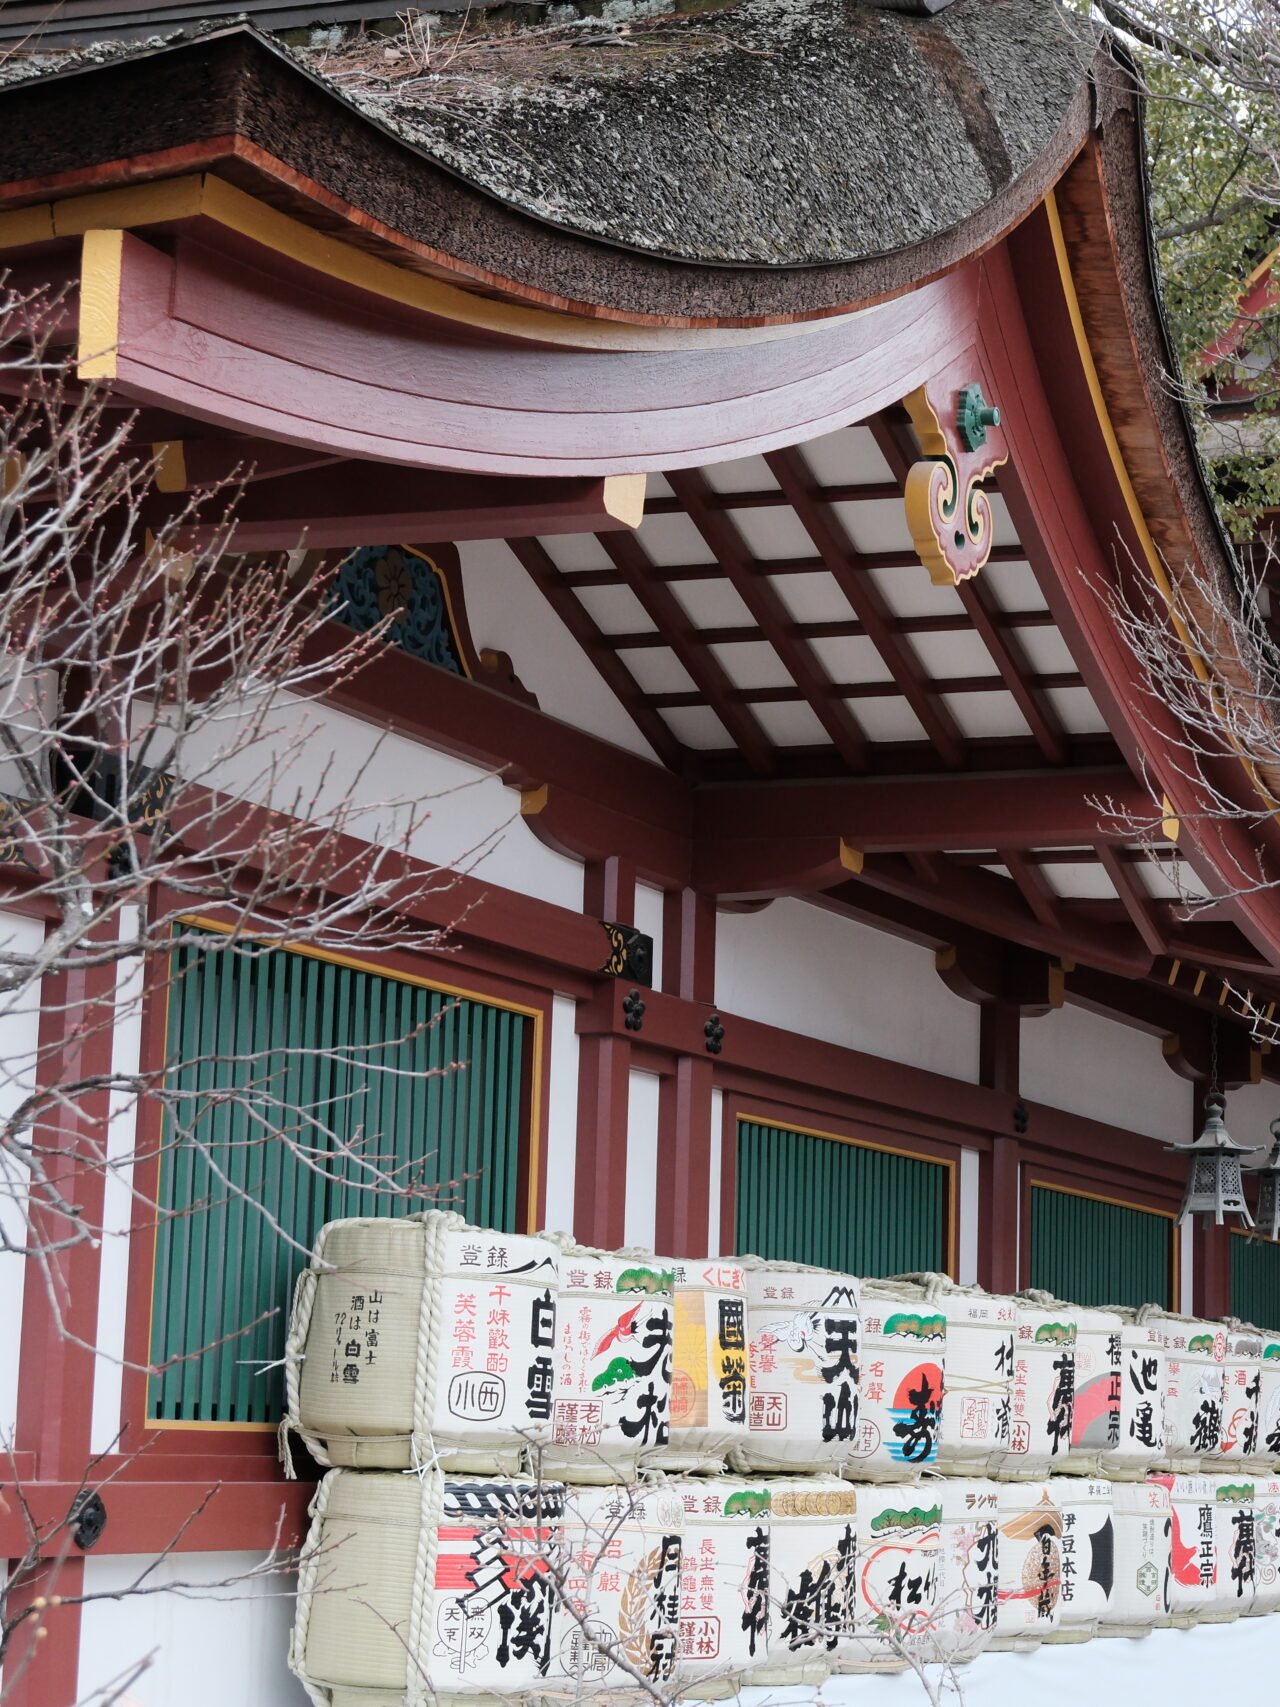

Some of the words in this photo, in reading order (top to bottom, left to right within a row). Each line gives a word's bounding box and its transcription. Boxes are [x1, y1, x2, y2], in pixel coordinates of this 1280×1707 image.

[566, 1269, 614, 1291] 登録
[342, 1295, 365, 1385] 酒は白雪
[365, 1289, 383, 1366] 山は富士
[451, 1293, 477, 1370] 芙蓉霞
[864, 1317, 882, 1334] 録
[1018, 1325, 1034, 1340] 録
[817, 1317, 860, 1443] 天山
[766, 1396, 783, 1427] 天山
[1011, 1425, 1027, 1451] 小林
[1197, 1503, 1214, 1590] 鷹正宗
[695, 1620, 716, 1655] 小林
